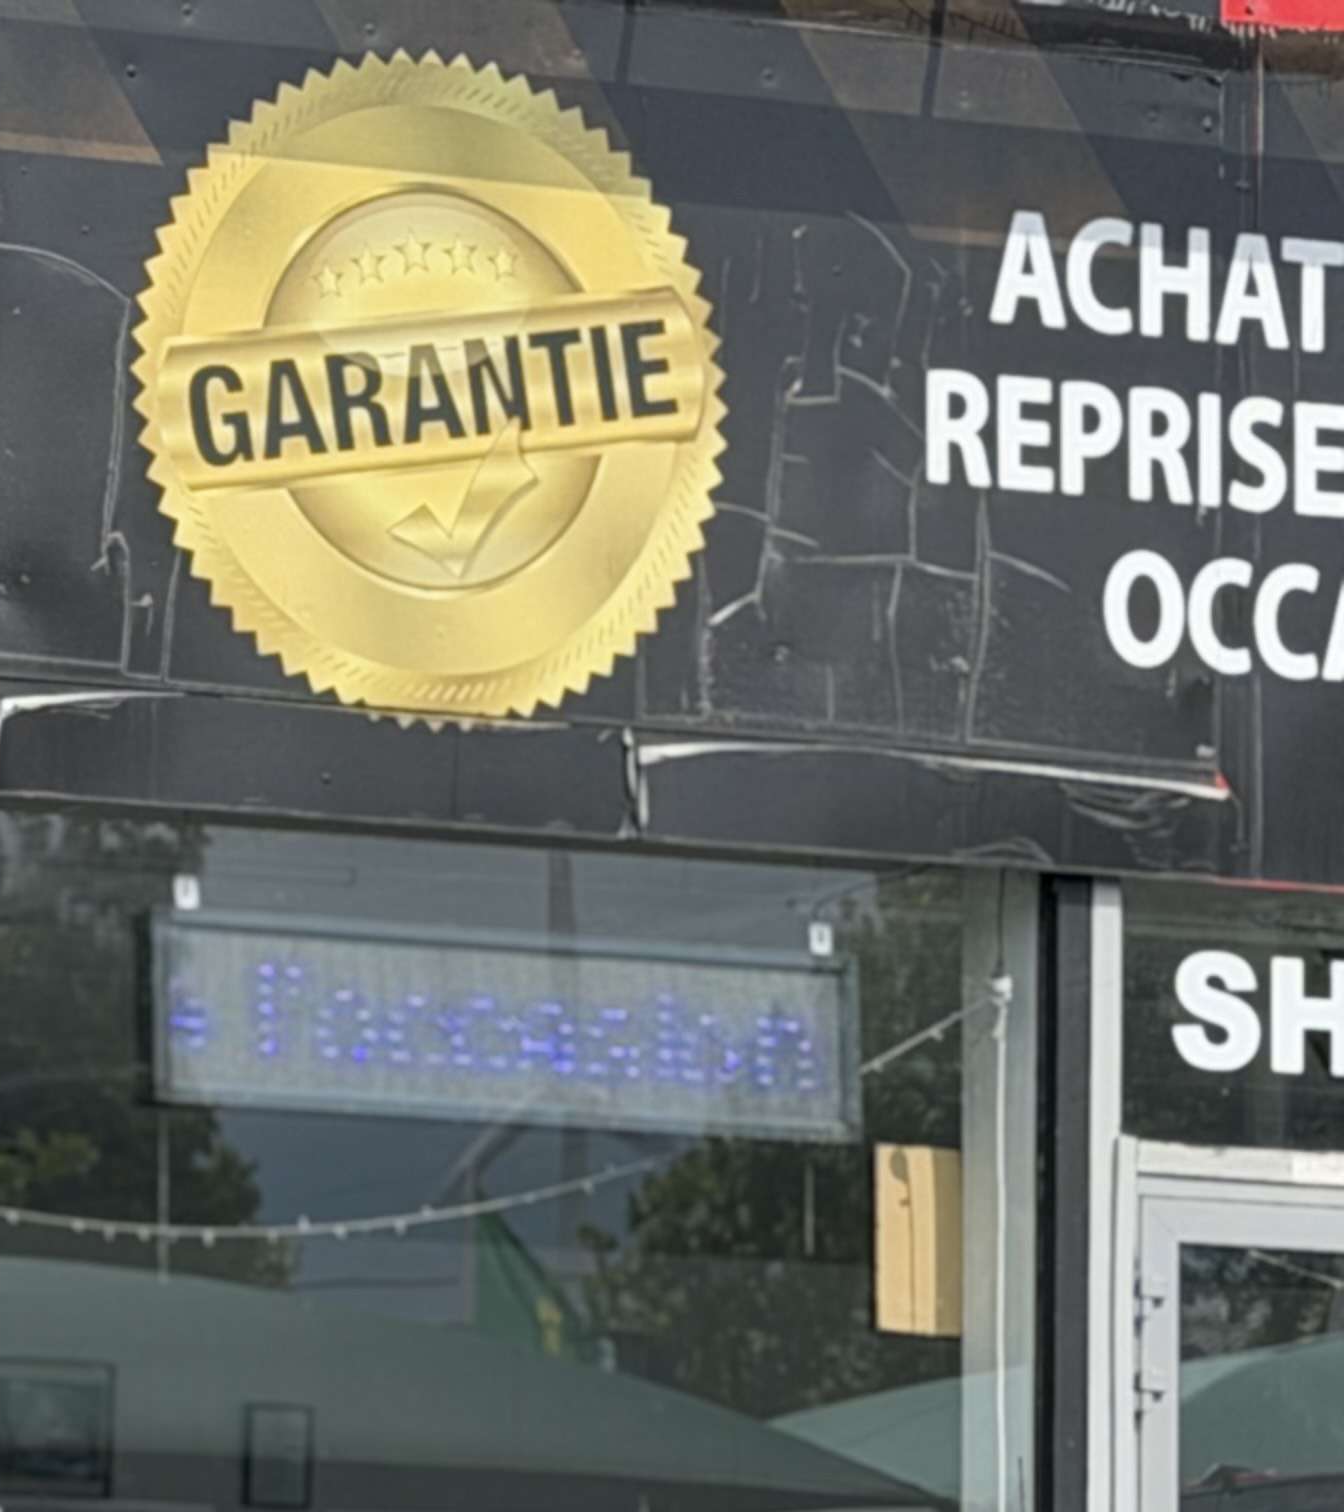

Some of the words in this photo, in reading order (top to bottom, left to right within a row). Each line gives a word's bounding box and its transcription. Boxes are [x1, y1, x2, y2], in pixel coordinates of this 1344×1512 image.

[990, 210, 1344, 353] ACHAT
[188, 319, 679, 467] GARANTIE
[926, 369, 1344, 519] REPRISE
